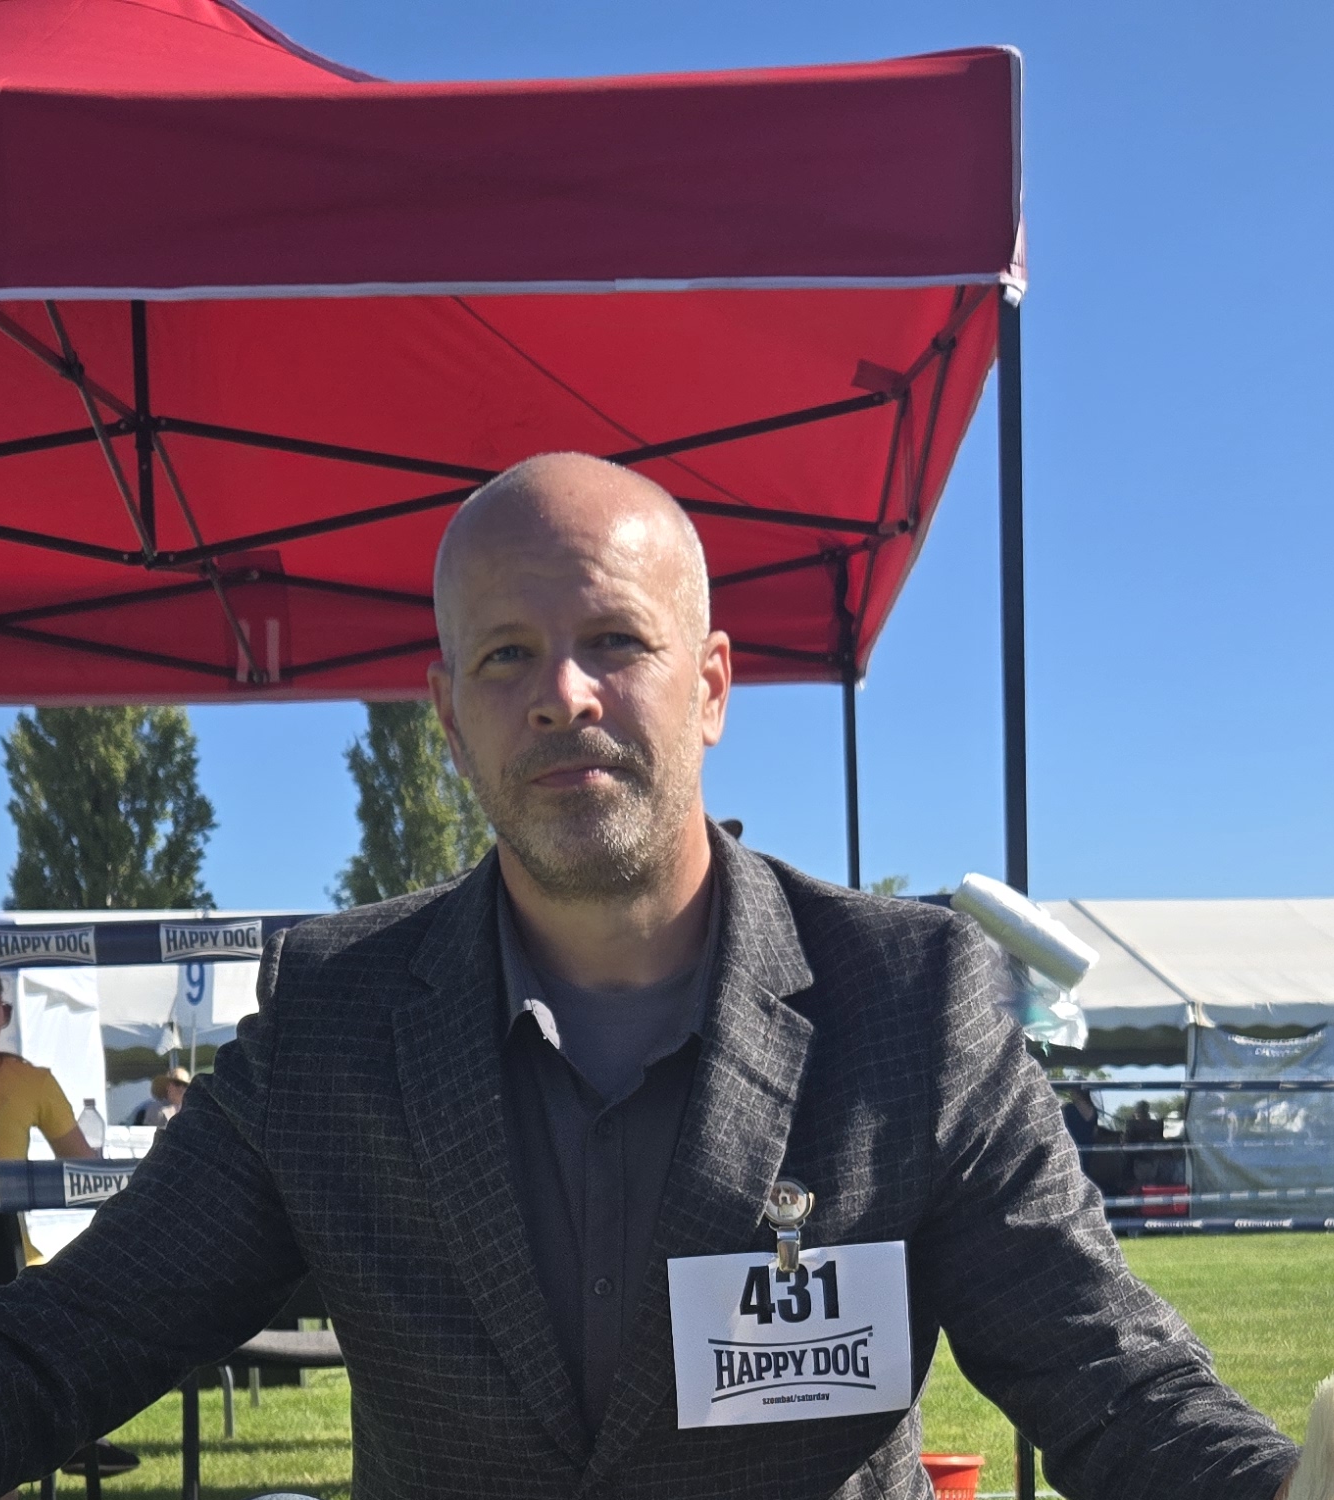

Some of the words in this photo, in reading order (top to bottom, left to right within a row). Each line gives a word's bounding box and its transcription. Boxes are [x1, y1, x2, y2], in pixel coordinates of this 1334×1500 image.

[54, 932, 90, 955] DOG
[165, 928, 222, 955] HAPPY
[223, 926, 258, 949] DOG
[186, 962, 205, 1006] 9
[69, 1172, 125, 1197] HAPPY
[739, 1260, 840, 1325] 431
[713, 1349, 808, 1391] HAPPY
[810, 1338, 870, 1378] DOG
[762, 1392, 830, 1405] szombat/saturday
